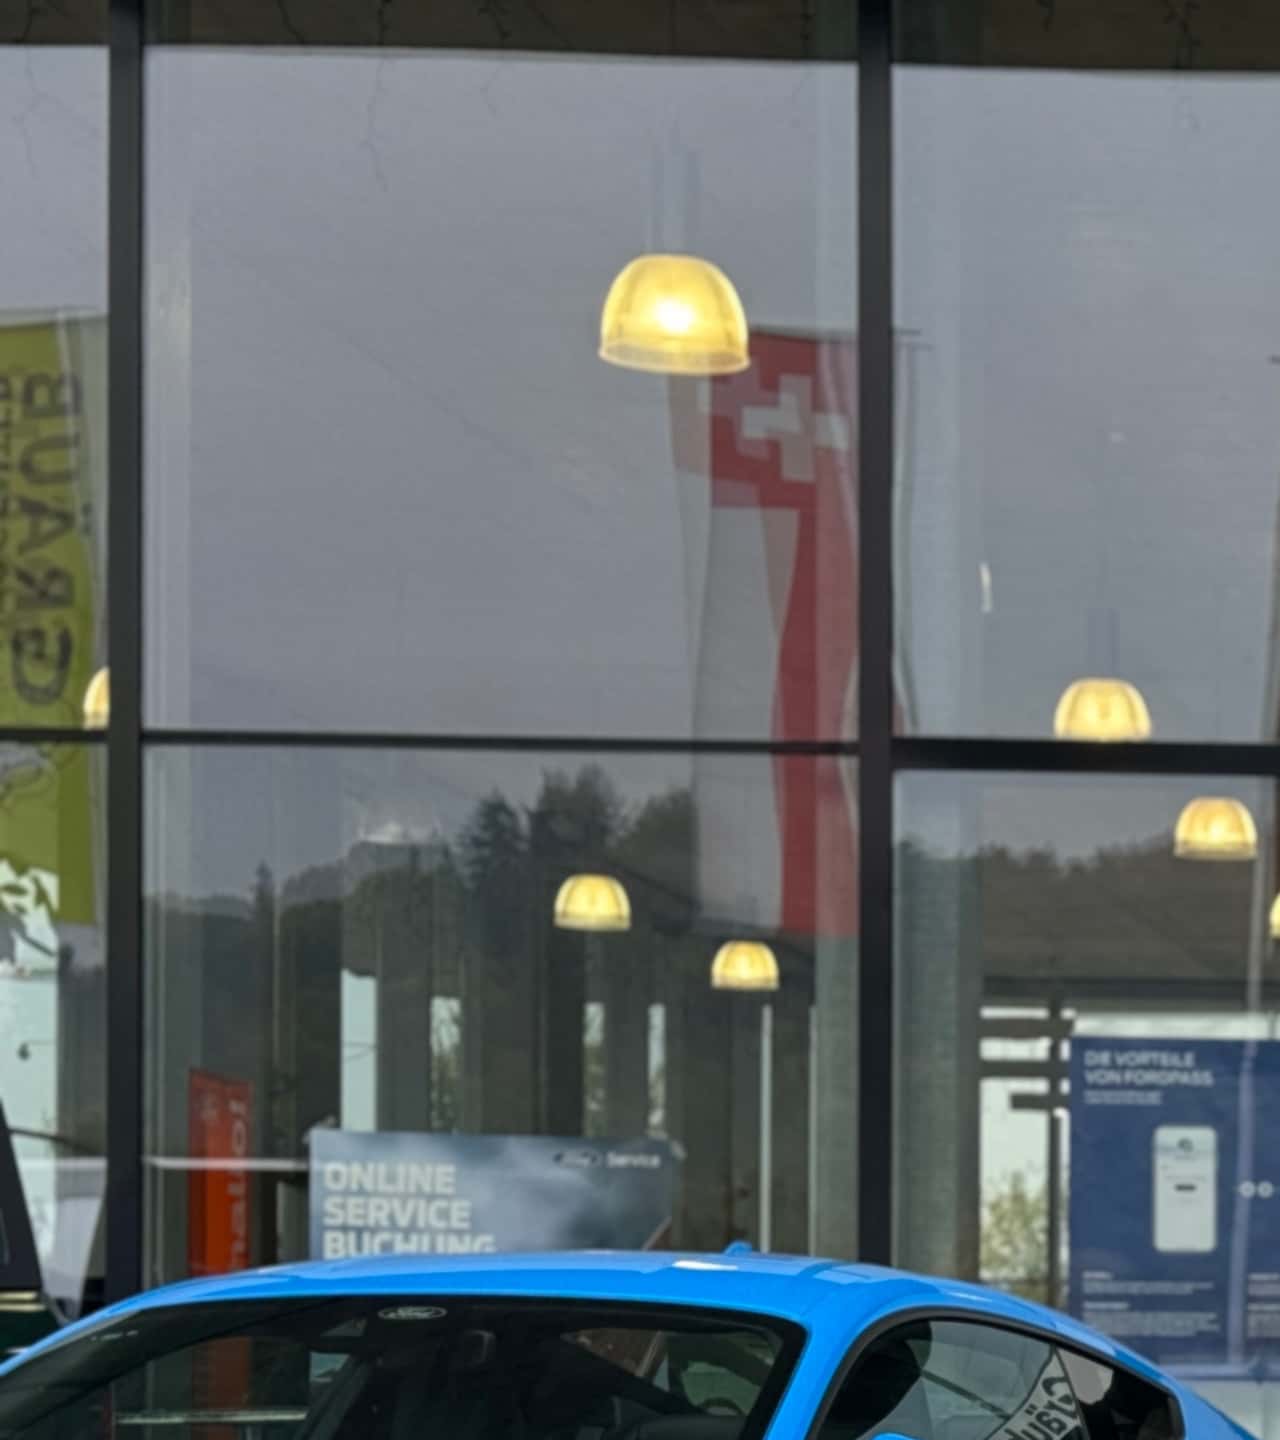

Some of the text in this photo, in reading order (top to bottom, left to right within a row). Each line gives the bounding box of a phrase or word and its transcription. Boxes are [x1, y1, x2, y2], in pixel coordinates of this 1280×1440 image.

[606, 1153, 660, 1169] Service
[323, 1163, 456, 1195] ONLINE
[323, 1198, 473, 1230] SERVICE
